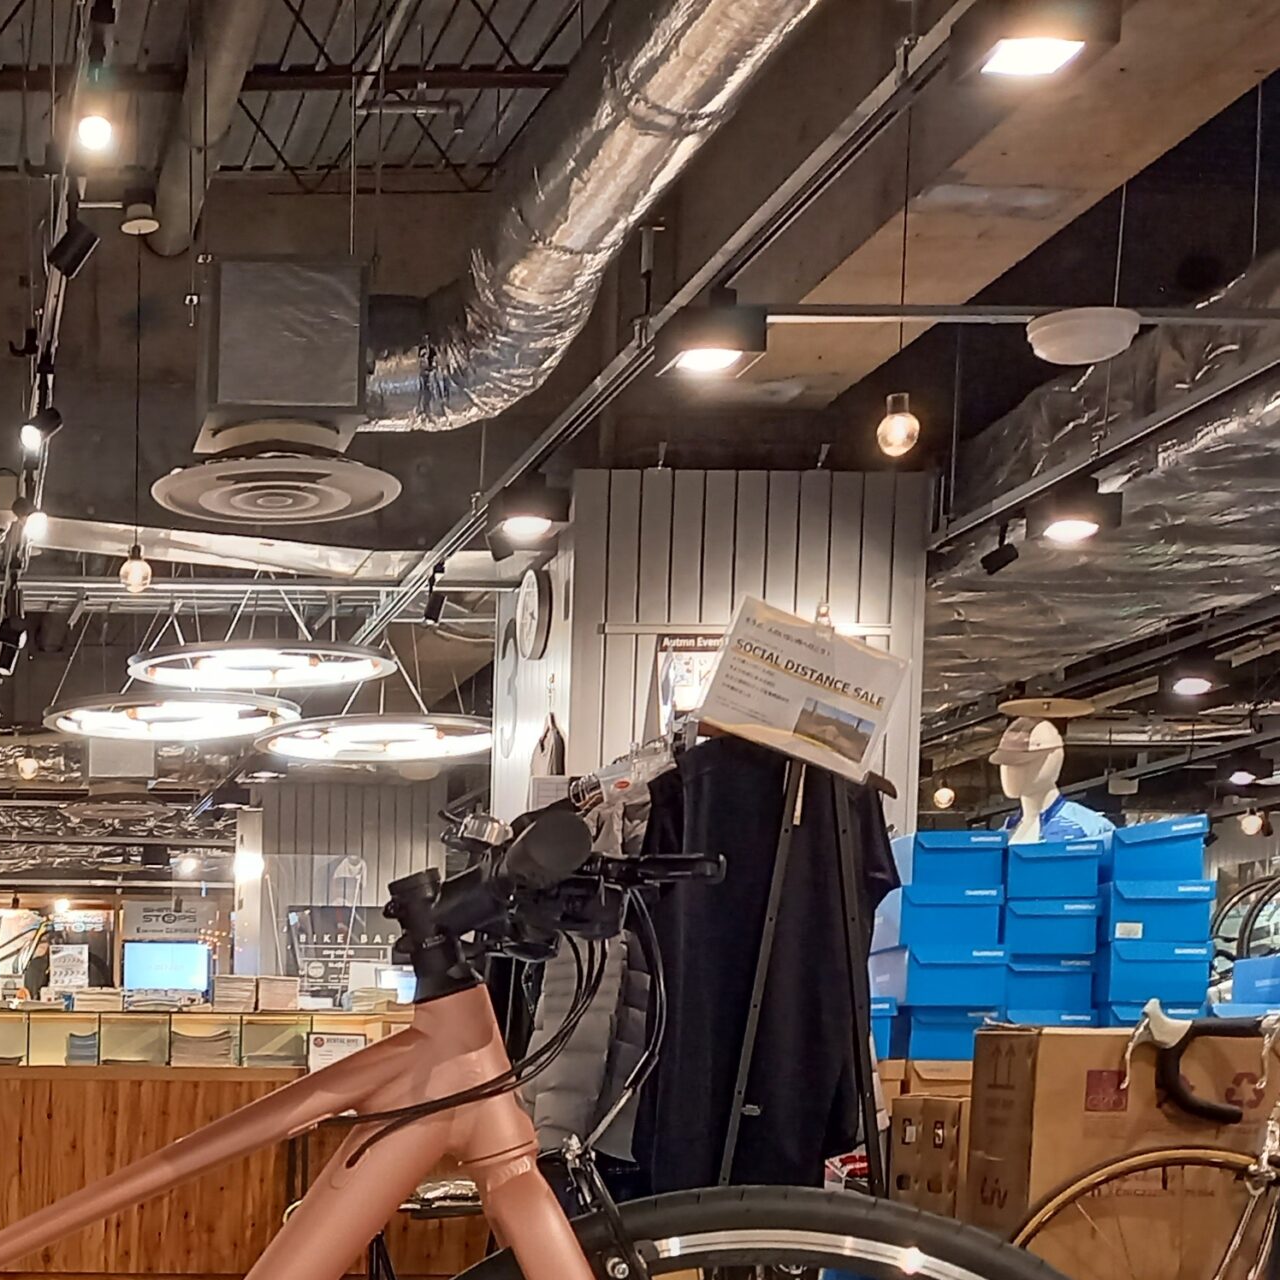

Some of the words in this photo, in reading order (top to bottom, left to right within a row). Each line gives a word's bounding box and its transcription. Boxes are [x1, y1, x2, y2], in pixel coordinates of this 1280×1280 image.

[736, 638, 781, 665] SOCIAL
[784, 658, 850, 694] DISTANCE
[853, 686, 885, 707] SALE
[299, 934, 345, 943] BIKE
[360, 934, 396, 943] BAS
